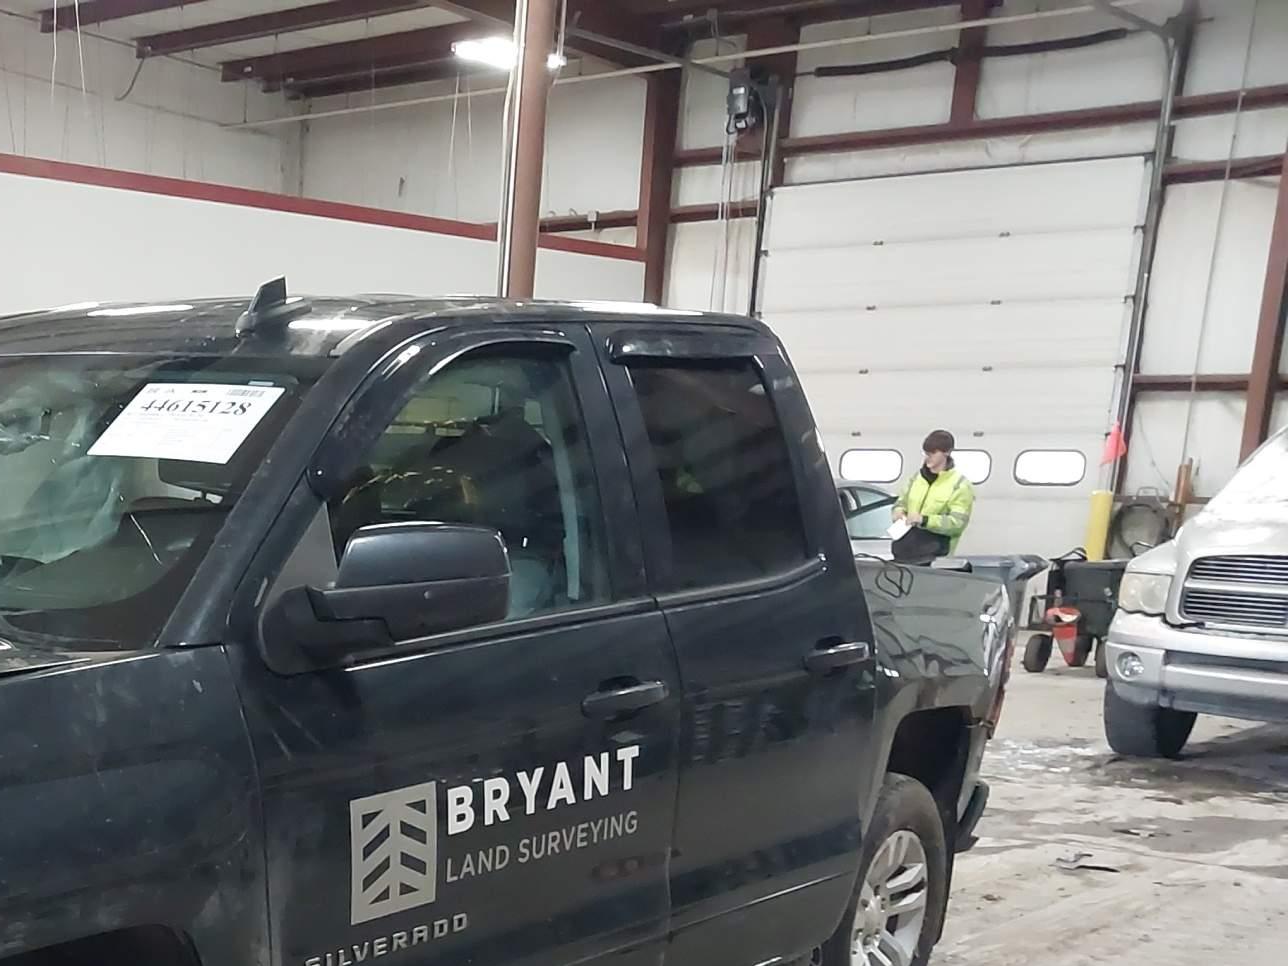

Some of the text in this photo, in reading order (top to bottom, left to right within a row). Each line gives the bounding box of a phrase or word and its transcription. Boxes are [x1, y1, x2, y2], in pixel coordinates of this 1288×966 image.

[140, 399, 252, 416] 44615128
[447, 745, 640, 836] BRYANT
[446, 810, 639, 883] LAND SURVEYING
